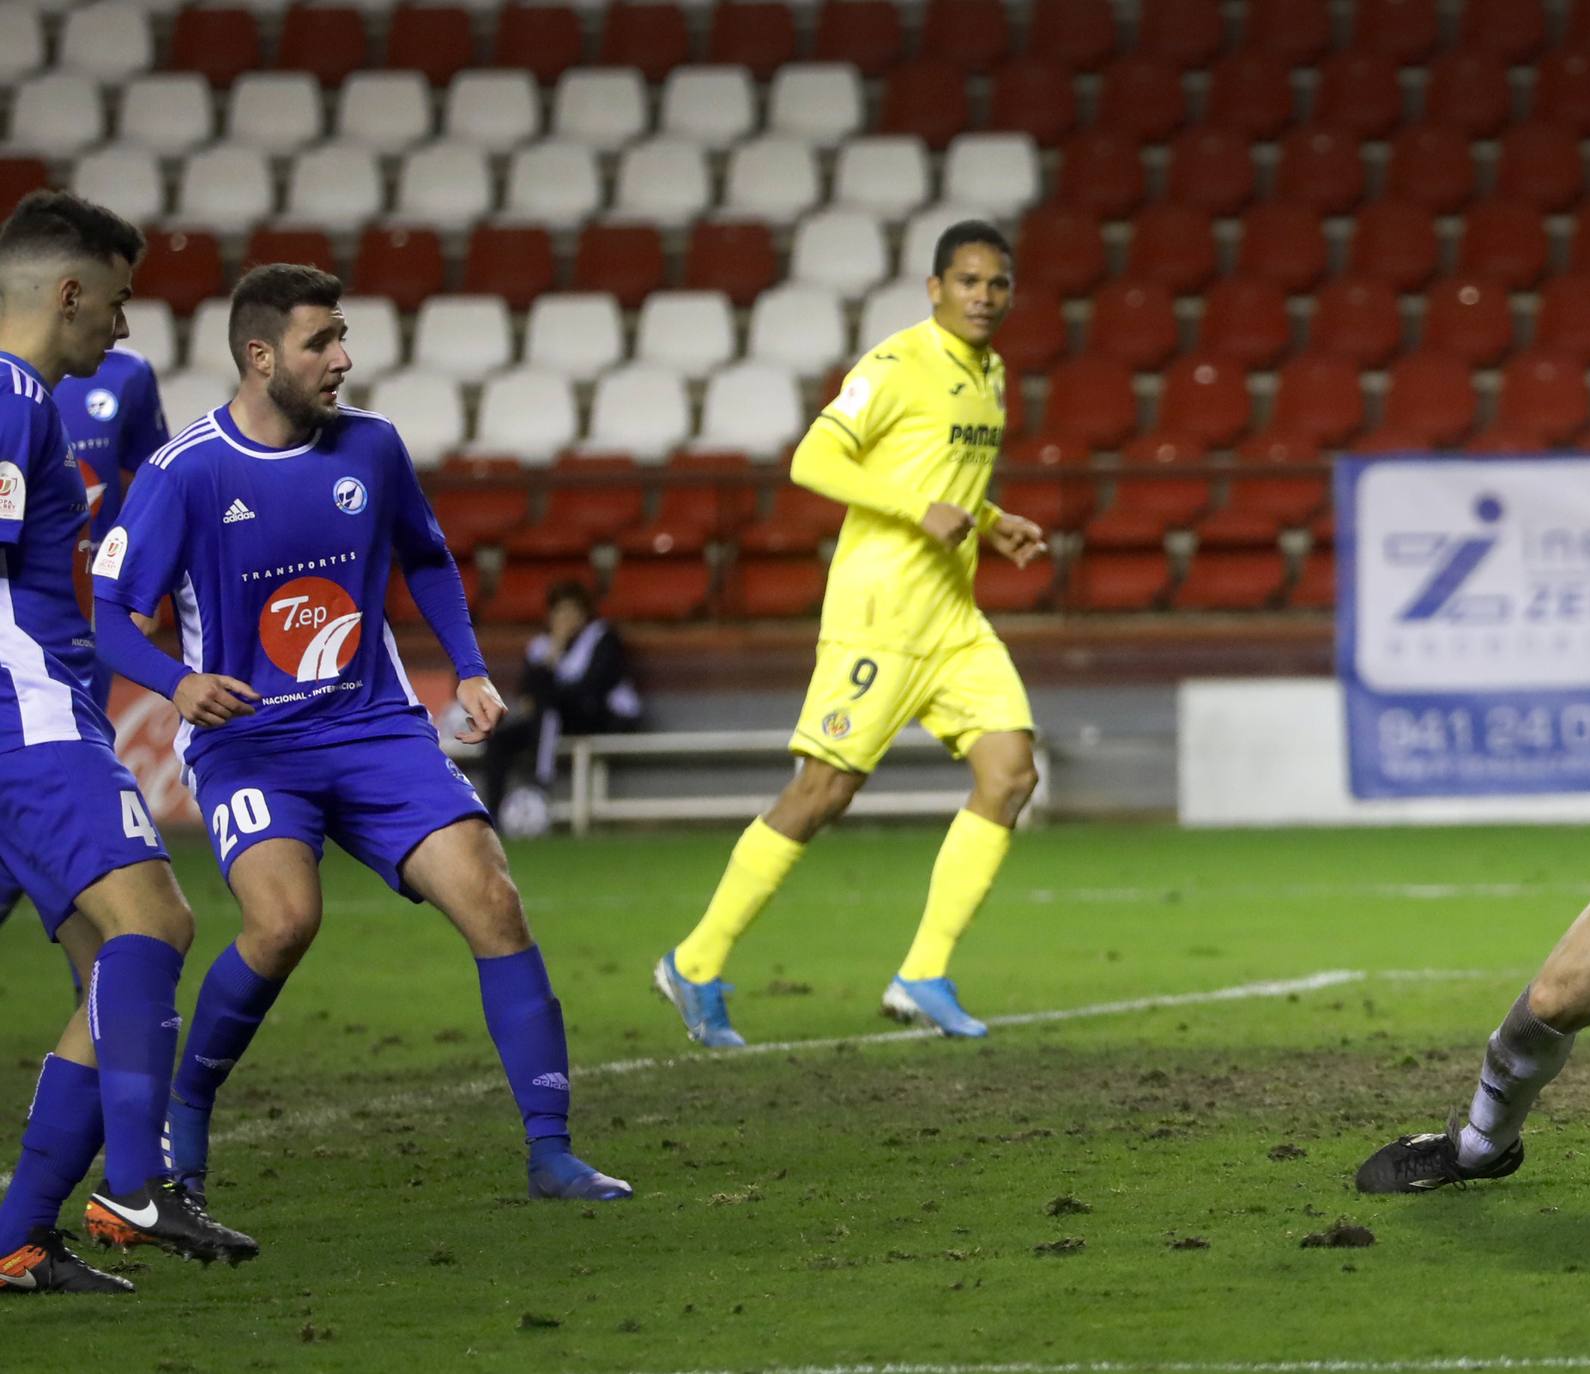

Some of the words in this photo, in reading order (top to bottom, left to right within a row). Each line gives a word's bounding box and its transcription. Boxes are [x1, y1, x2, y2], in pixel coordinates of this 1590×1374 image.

[223, 511, 256, 524] adidas
[242, 552, 356, 582] TRANSPORTES
[262, 692, 307, 705] NACIONAL
[850, 658, 878, 700] 9
[1379, 705, 1473, 752] 941
[1485, 704, 1553, 749] 24
[120, 790, 158, 846] 4
[213, 788, 271, 861] 20
